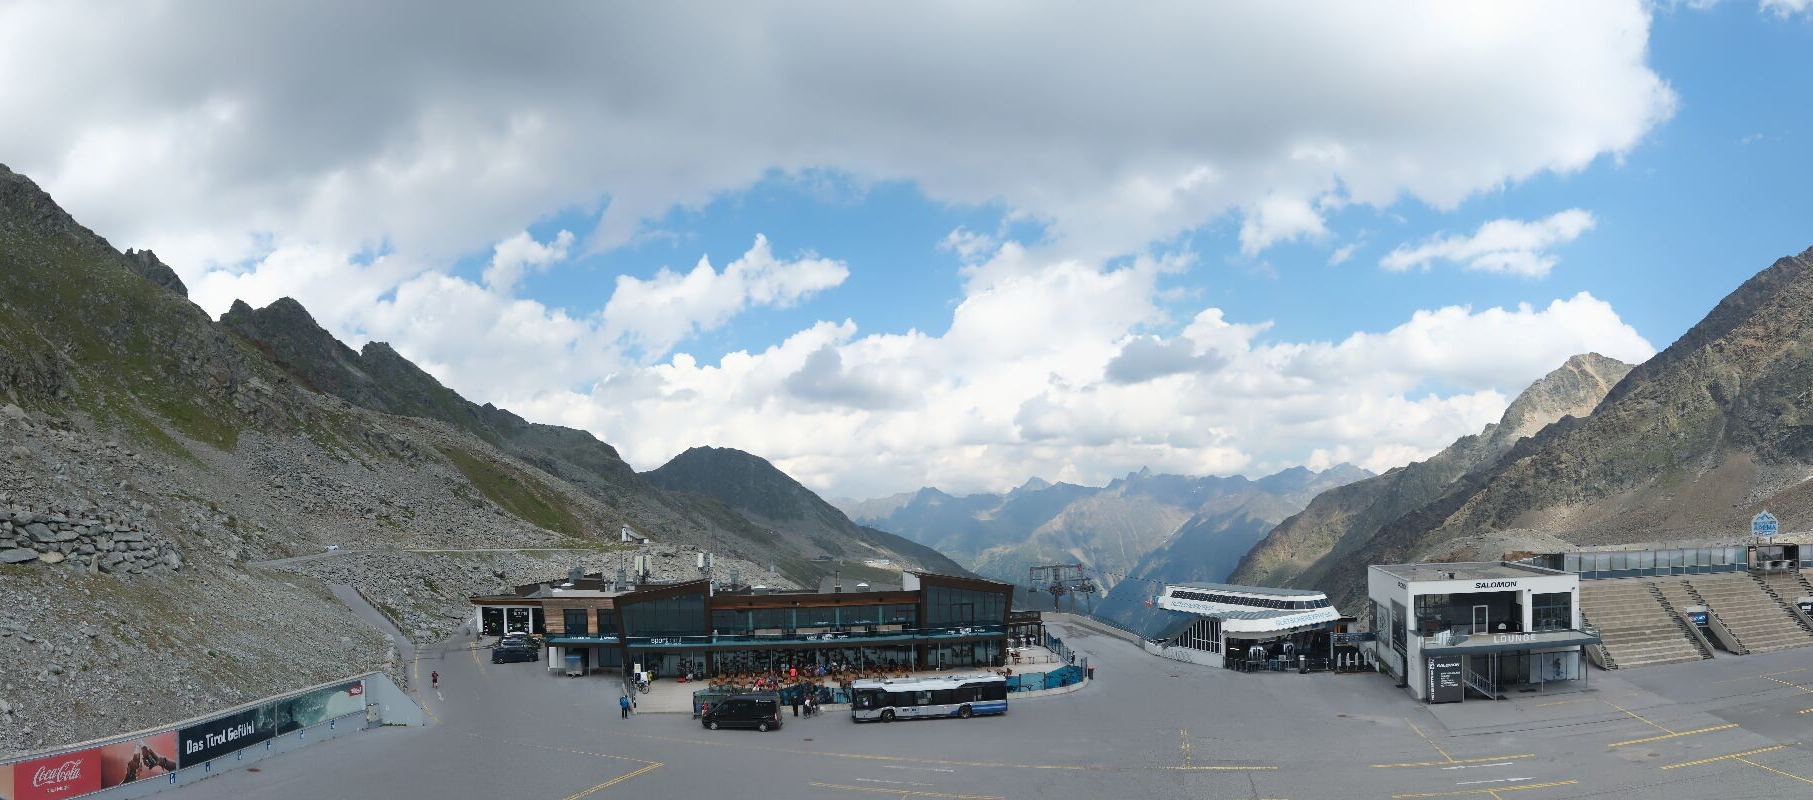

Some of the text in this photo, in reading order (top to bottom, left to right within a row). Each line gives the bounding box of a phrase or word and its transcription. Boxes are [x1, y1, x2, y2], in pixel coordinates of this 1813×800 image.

[1493, 634, 1536, 643] LOUNGE
[186, 720, 255, 755] Das Tirol Gefühl
[32, 759, 83, 787] Coca-Cola
